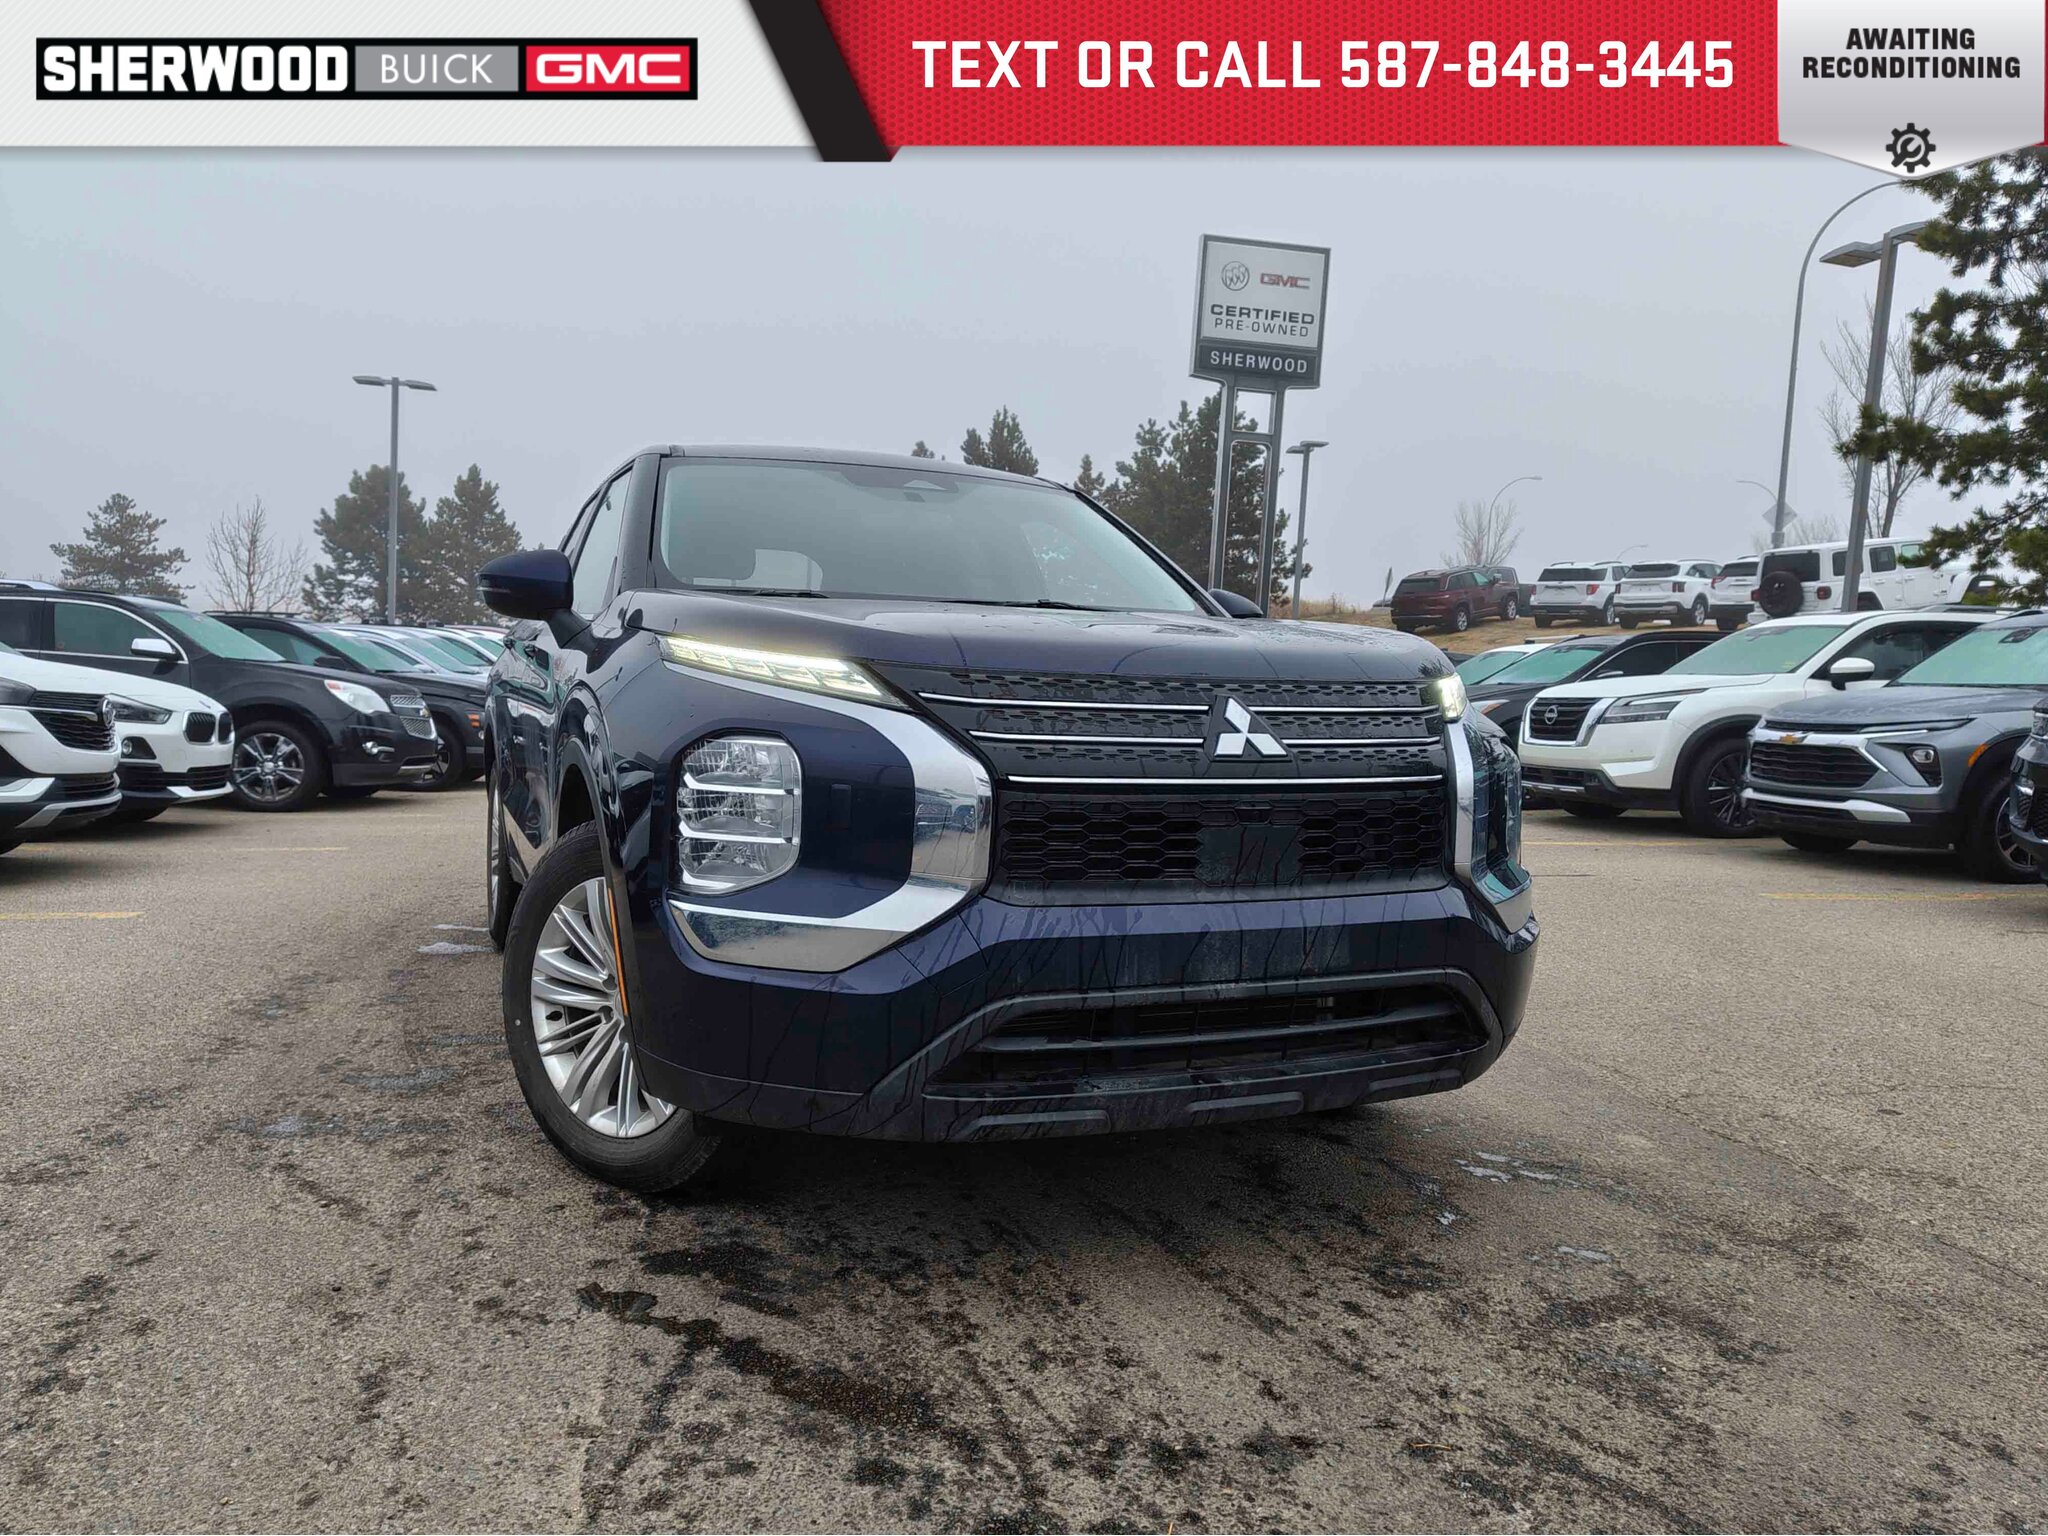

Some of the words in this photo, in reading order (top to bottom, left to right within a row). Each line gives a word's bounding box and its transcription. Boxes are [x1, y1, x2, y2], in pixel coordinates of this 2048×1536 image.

[1260, 273, 1310, 290] GMC
[1210, 304, 1315, 325] CERTIFIED
[1214, 317, 1309, 337] PRE-OWNED
[1210, 350, 1308, 373] SHERWOOD
